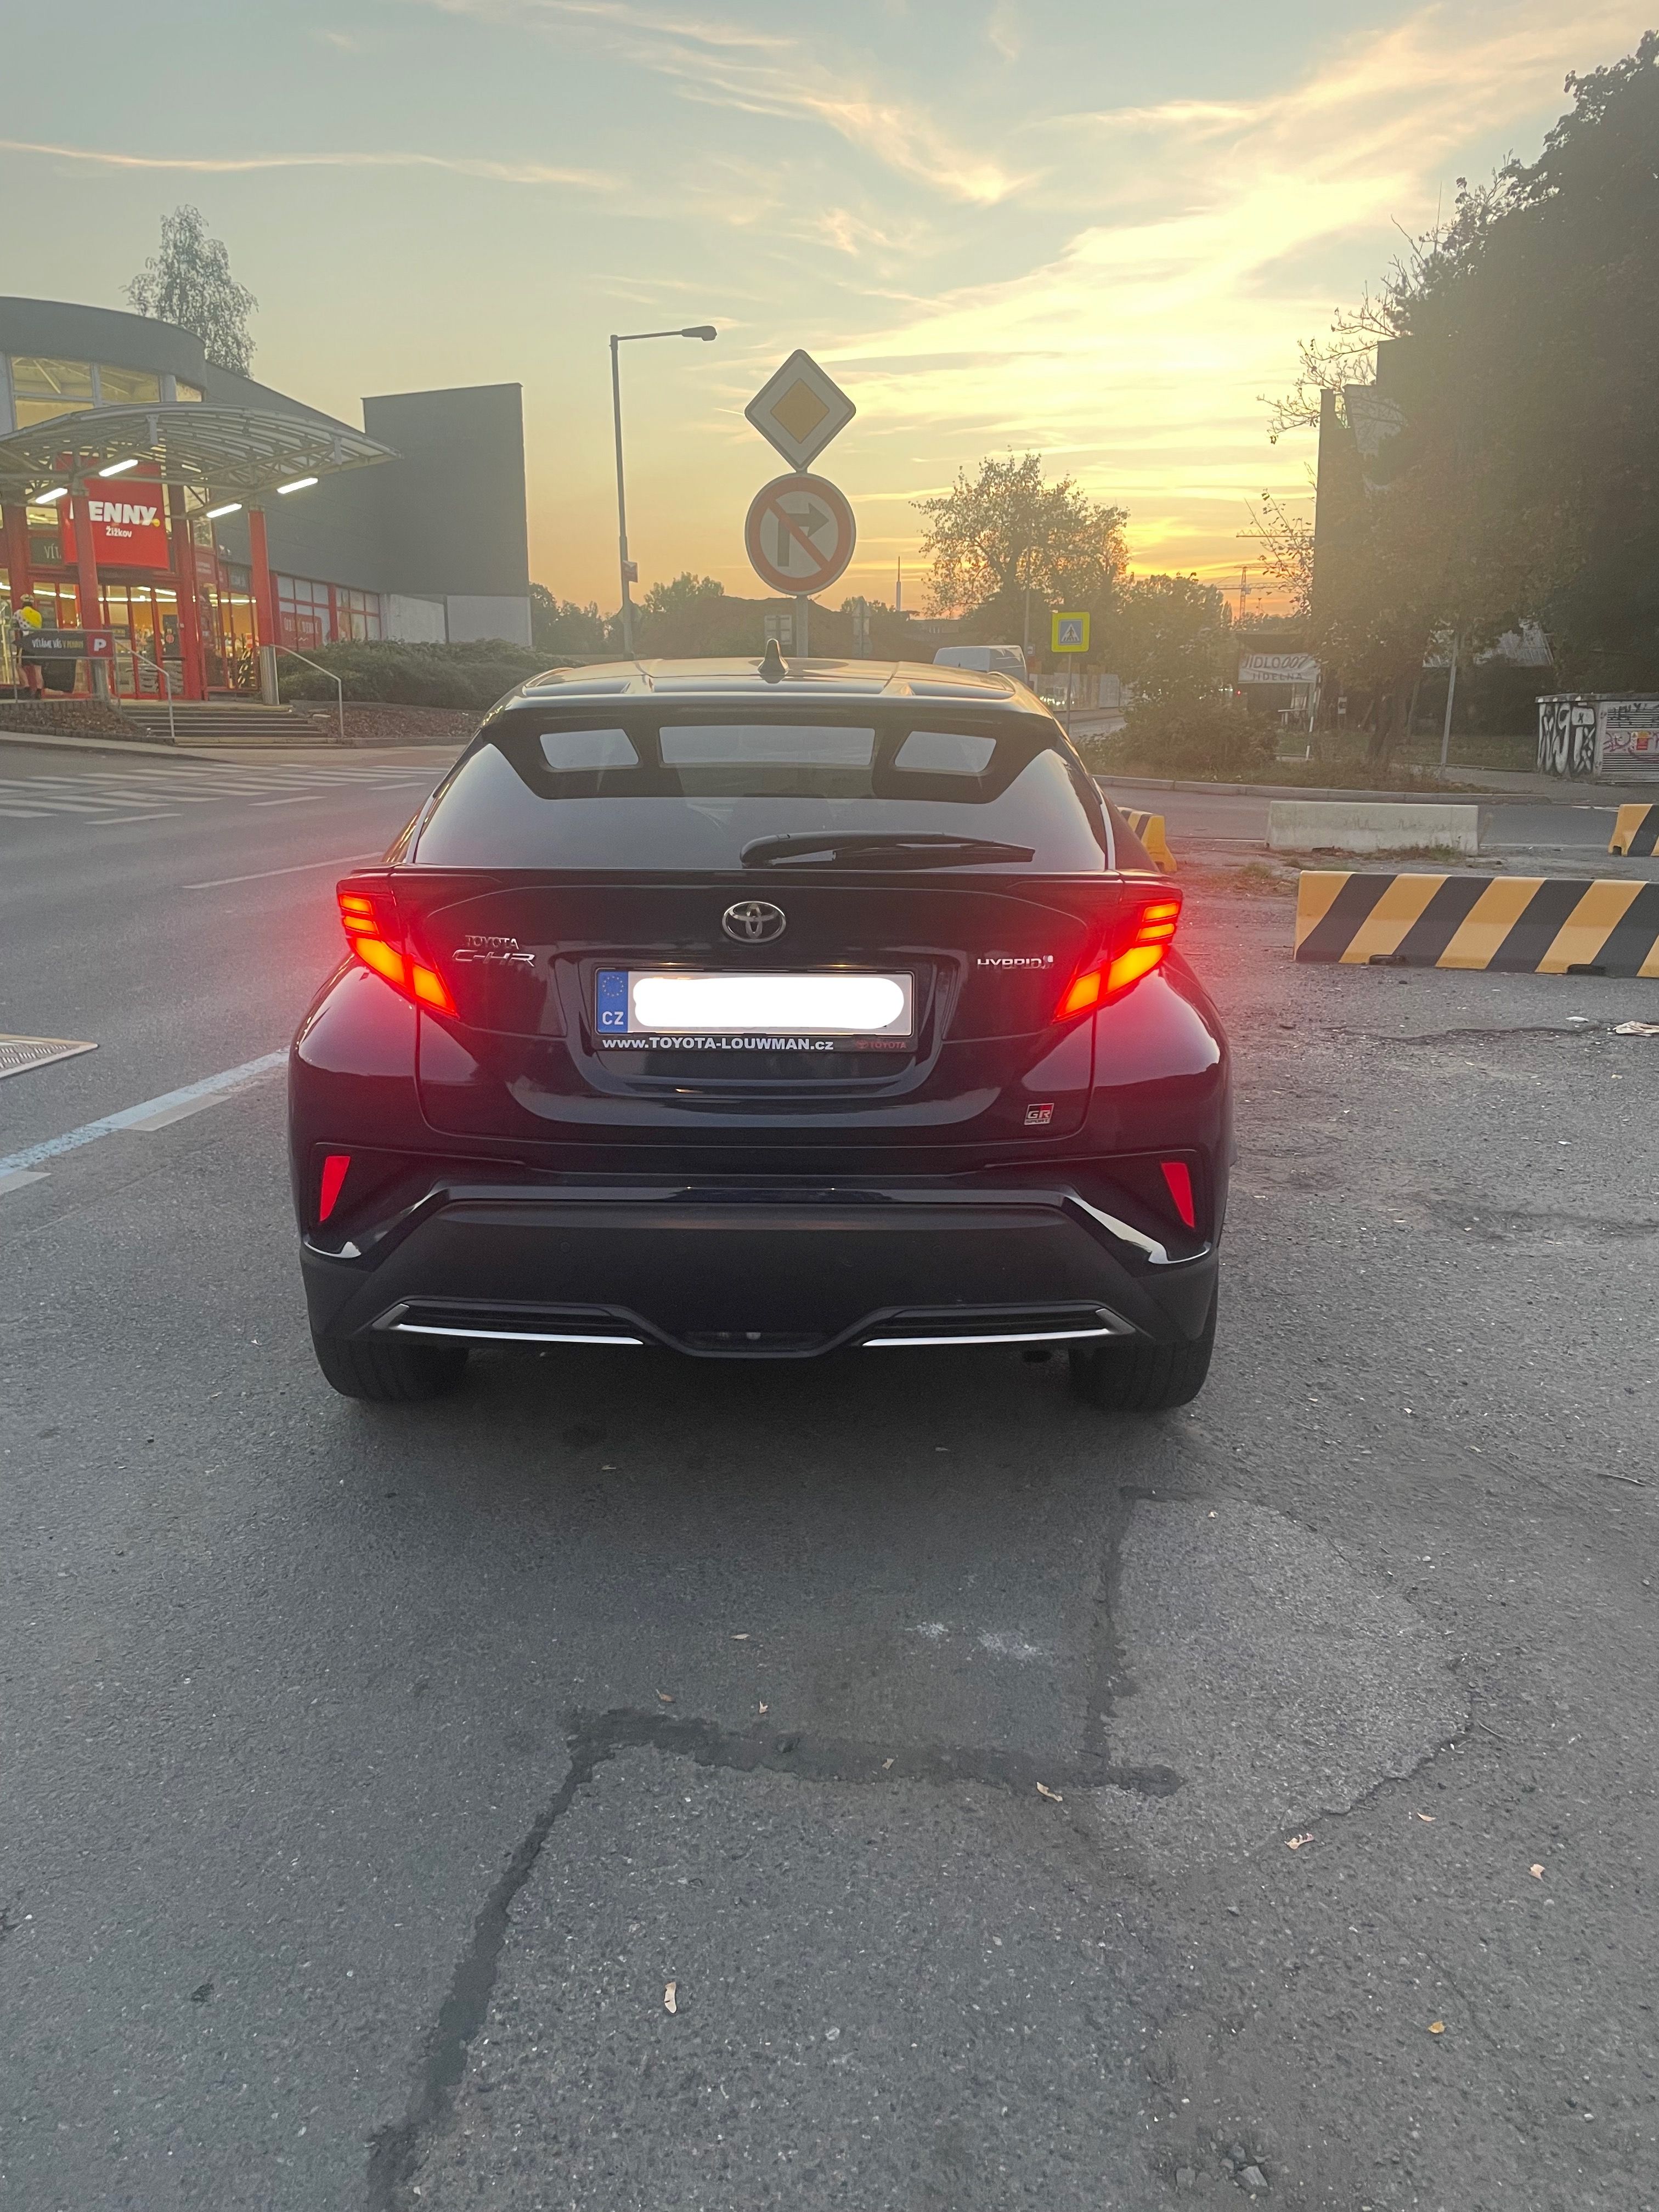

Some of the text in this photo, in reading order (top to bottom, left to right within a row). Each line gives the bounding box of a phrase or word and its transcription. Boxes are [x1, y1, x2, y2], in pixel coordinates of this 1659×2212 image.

[106, 525, 132, 538] Žižkov
[44, 543, 61, 559] VÍT
[94, 639, 106, 651] P
[465, 935, 520, 950] TOYOTA
[452, 949, 535, 967] C-HR
[977, 958, 1042, 969] HYBRID
[602, 1011, 624, 1025] CZ
[602, 1037, 833, 1050] www.TOYOTA-LOUWMAN.cz
[870, 1041, 907, 1049] TOYOTA
[1028, 1110, 1051, 1119] GR
